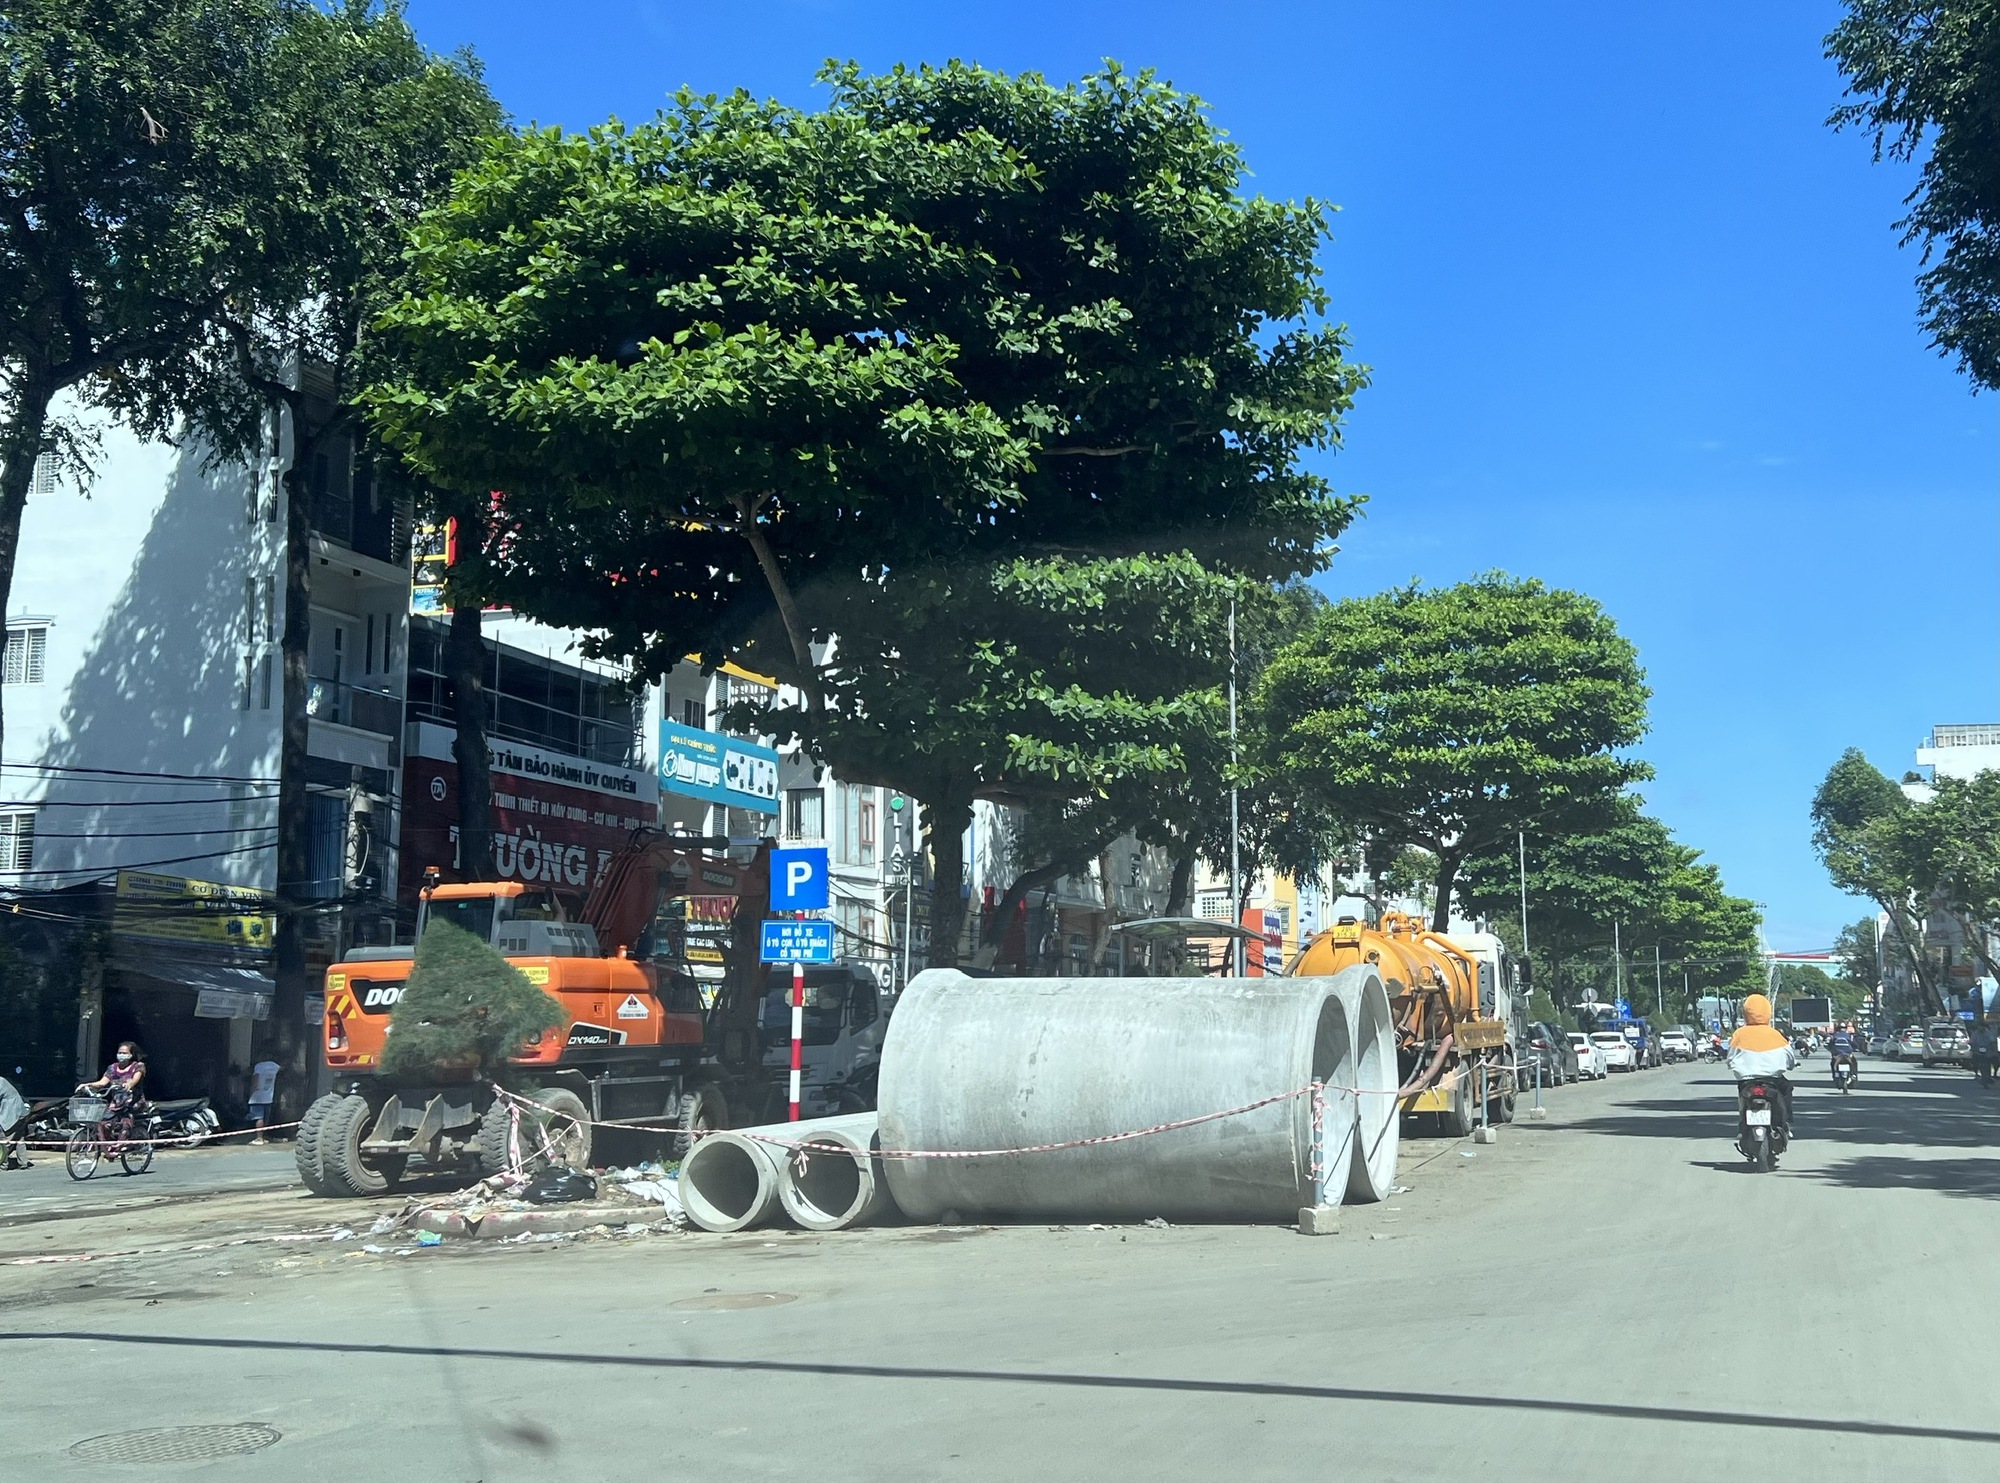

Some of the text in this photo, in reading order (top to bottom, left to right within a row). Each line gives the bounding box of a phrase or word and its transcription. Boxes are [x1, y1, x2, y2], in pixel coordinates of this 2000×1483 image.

[525, 754, 550, 776] BẢO
[551, 762, 583, 783] HÀNH
[584, 765, 600, 787] ỦY
[702, 870, 734, 886] DOOSAN
[787, 861, 812, 897] P
[805, 928, 814, 937] XE
